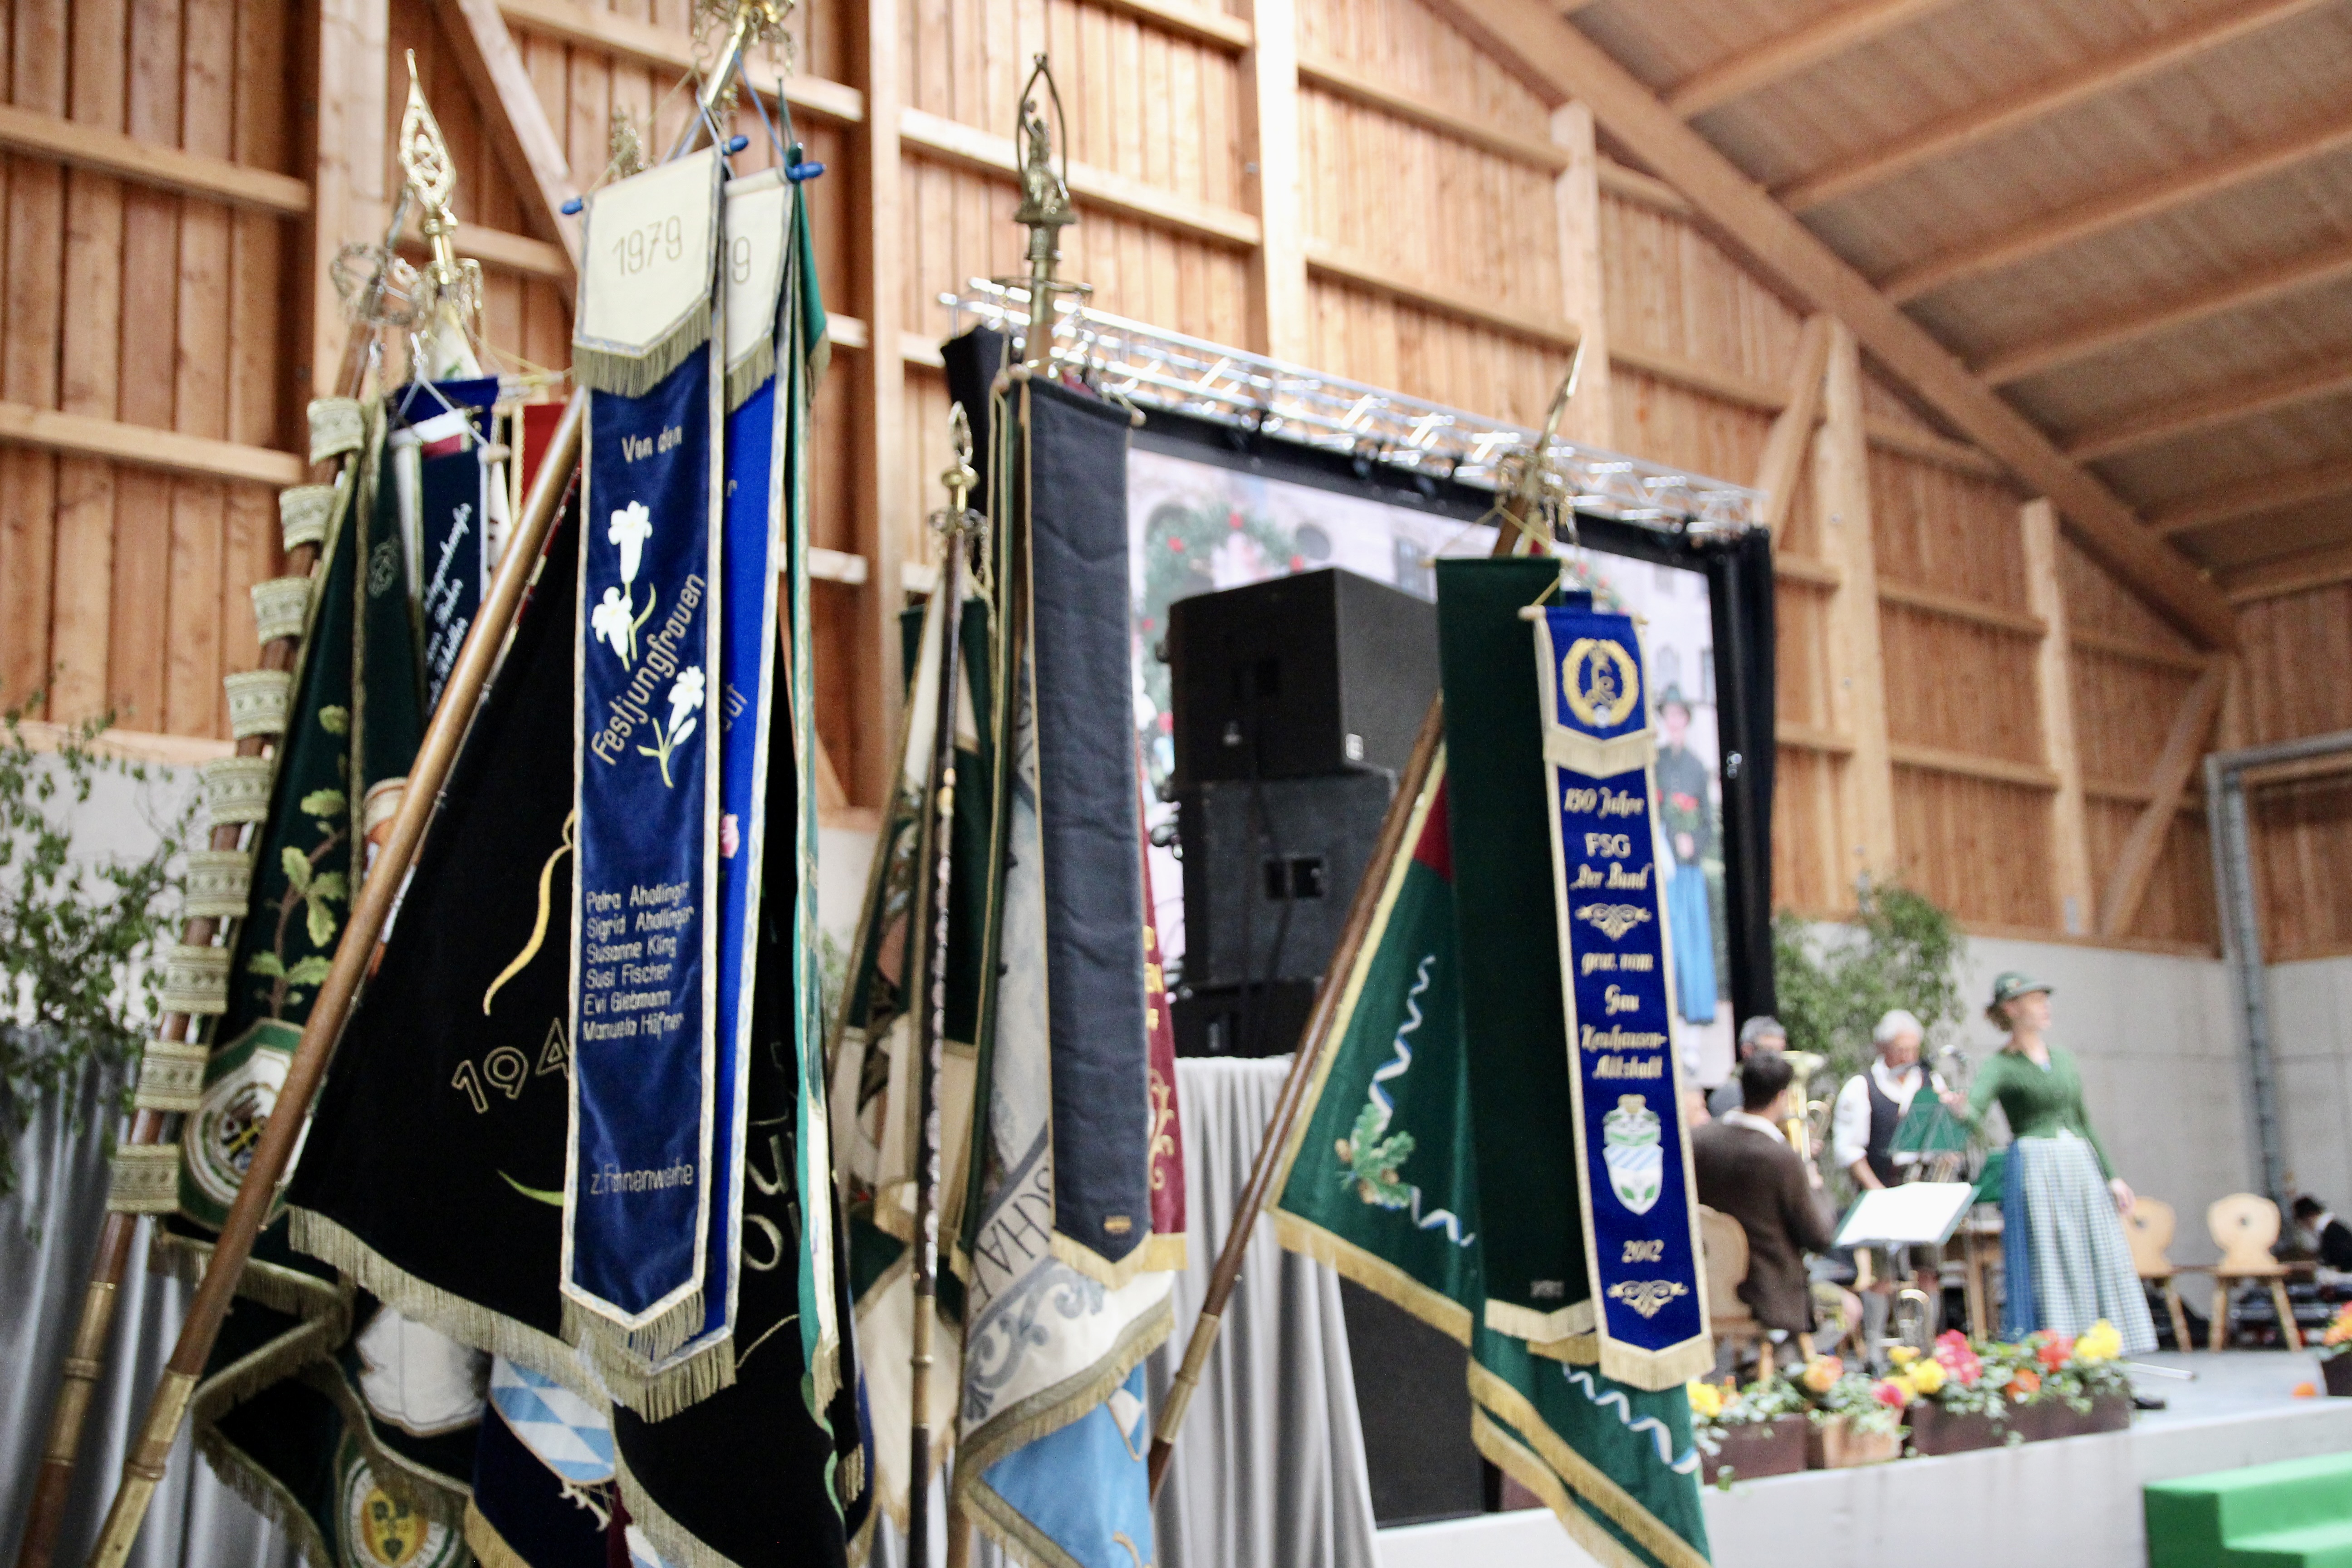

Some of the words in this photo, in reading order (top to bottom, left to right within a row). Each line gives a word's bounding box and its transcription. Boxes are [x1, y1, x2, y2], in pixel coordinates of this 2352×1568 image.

[612, 215, 683, 276] 1979
[621, 434, 653, 464] Von
[591, 573, 706, 766] Festjungfrauen
[1564, 788, 1597, 813] 150
[1597, 786, 1645, 818] Jahre
[1584, 832, 1631, 858] FSG
[586, 889, 622, 913] Petra
[586, 912, 627, 943] Sigrid
[586, 942, 643, 965] Susanne
[585, 966, 616, 990] Susi
[621, 961, 673, 986] Fischer
[583, 992, 607, 1016] Evi
[583, 1016, 637, 1042] Manuela
[1621, 1239, 1665, 1263] 2012
